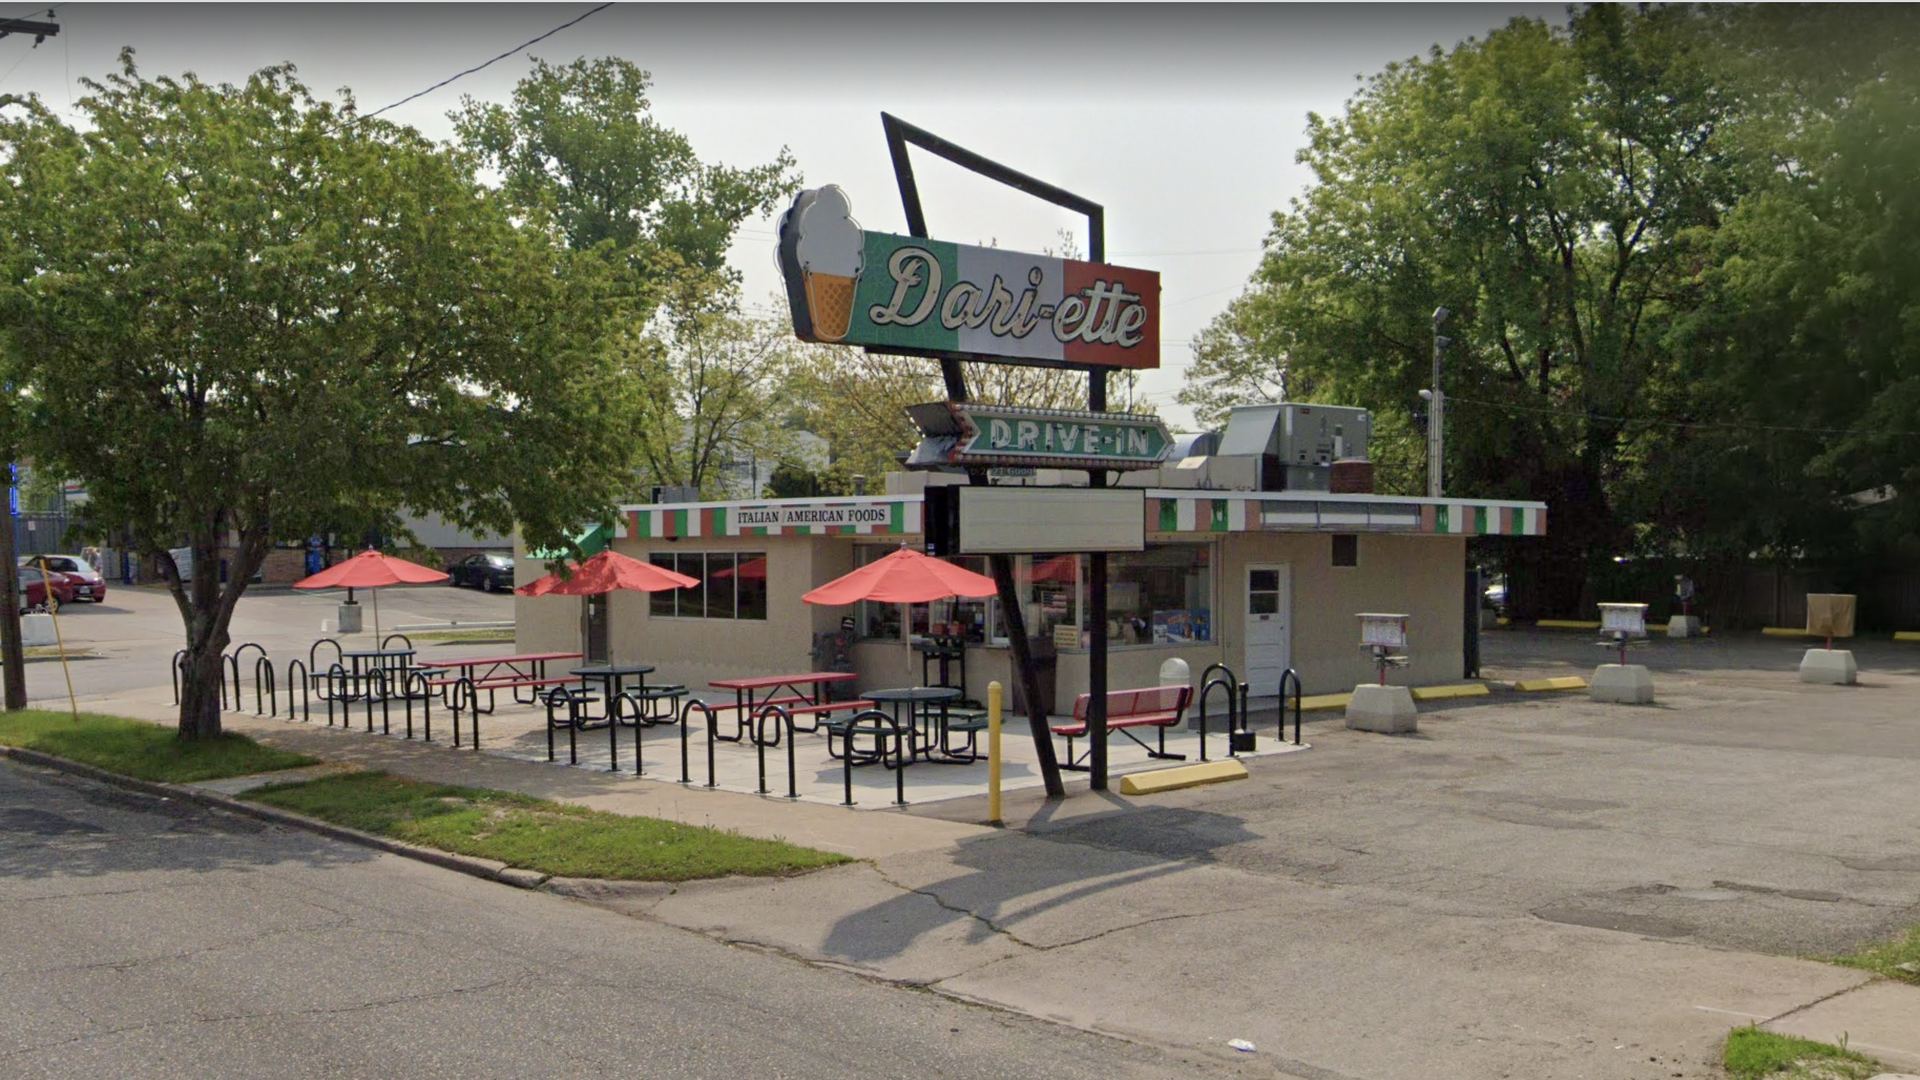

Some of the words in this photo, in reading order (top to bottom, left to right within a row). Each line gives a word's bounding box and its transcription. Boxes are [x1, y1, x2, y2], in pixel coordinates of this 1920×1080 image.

[869, 245, 1147, 348] Dari-ette
[990, 419, 1149, 455] DRIVE-IN
[738, 511, 779, 524] ITALIAN
[848, 508, 885, 522] FOODS
